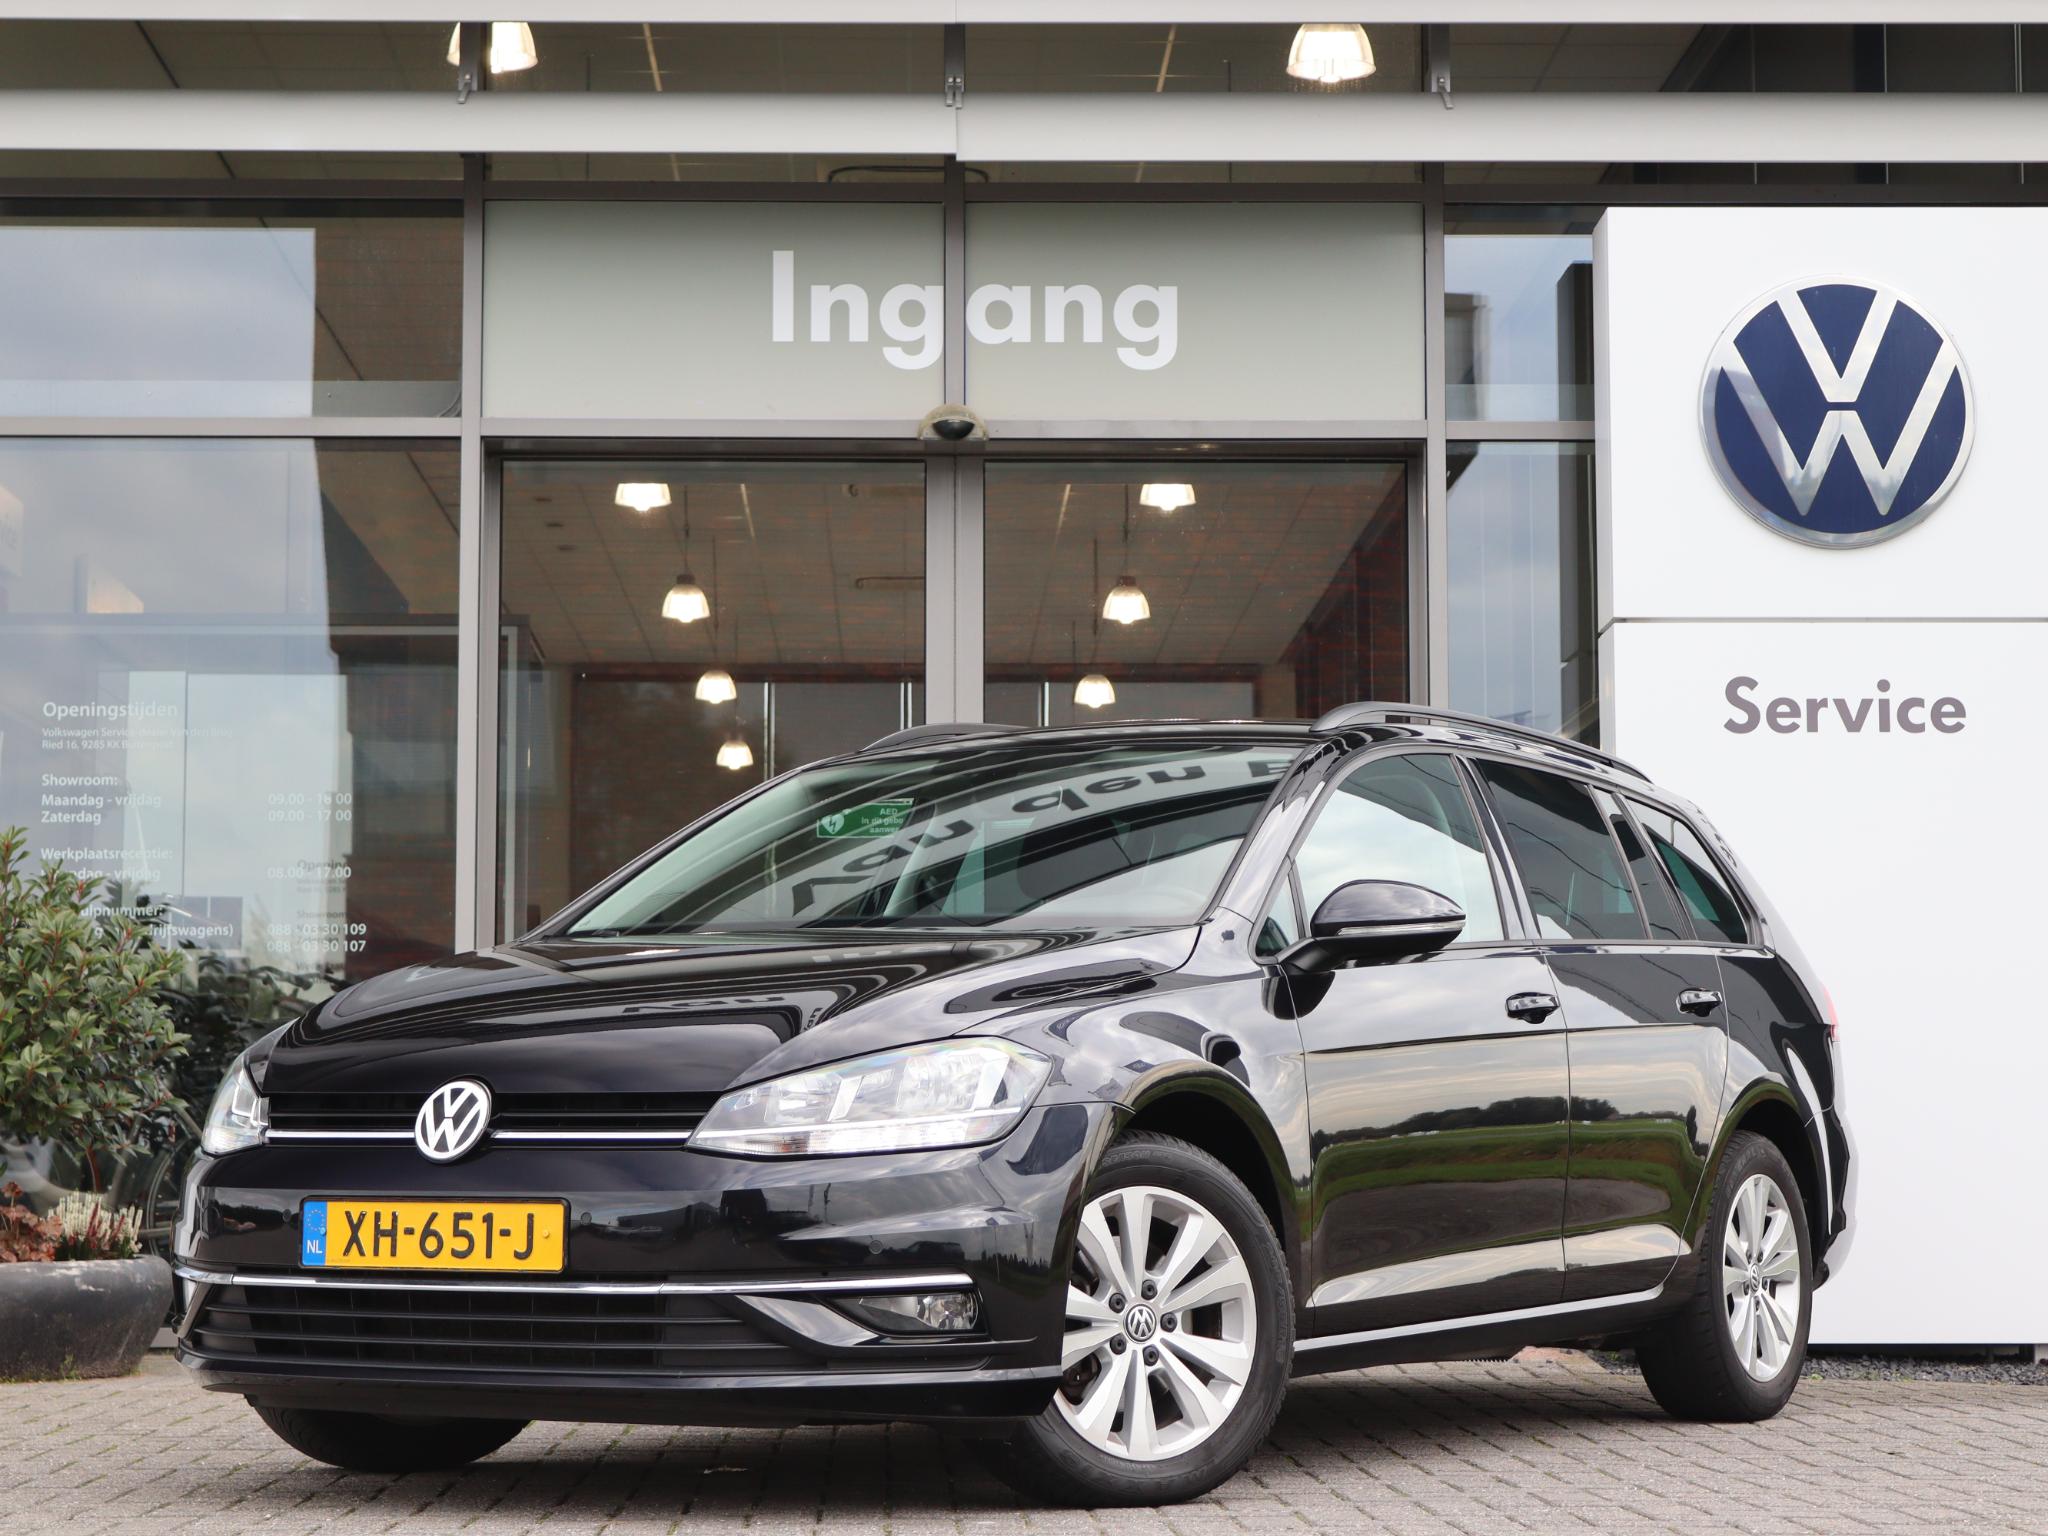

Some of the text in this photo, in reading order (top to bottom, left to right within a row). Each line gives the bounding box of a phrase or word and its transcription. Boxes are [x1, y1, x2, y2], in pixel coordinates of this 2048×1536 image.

[772, 250, 1178, 371] Ingang
[42, 701, 178, 721] Openingstijden
[1723, 676, 1968, 733] Service
[41, 728, 99, 738] Volkswagen
[41, 740, 64, 750] Ried
[41, 774, 119, 786] Showroom:
[41, 794, 103, 809] Maandag
[115, 793, 161, 809] vrijdag
[41, 810, 102, 825] Zaterdag
[318, 810, 352, 822] 1700
[880, 808, 898, 816] AED
[343, 923, 367, 935] 109
[343, 940, 367, 952] 107
[342, 1209, 535, 1260] XH-651-J
[306, 1239, 323, 1255] NL
